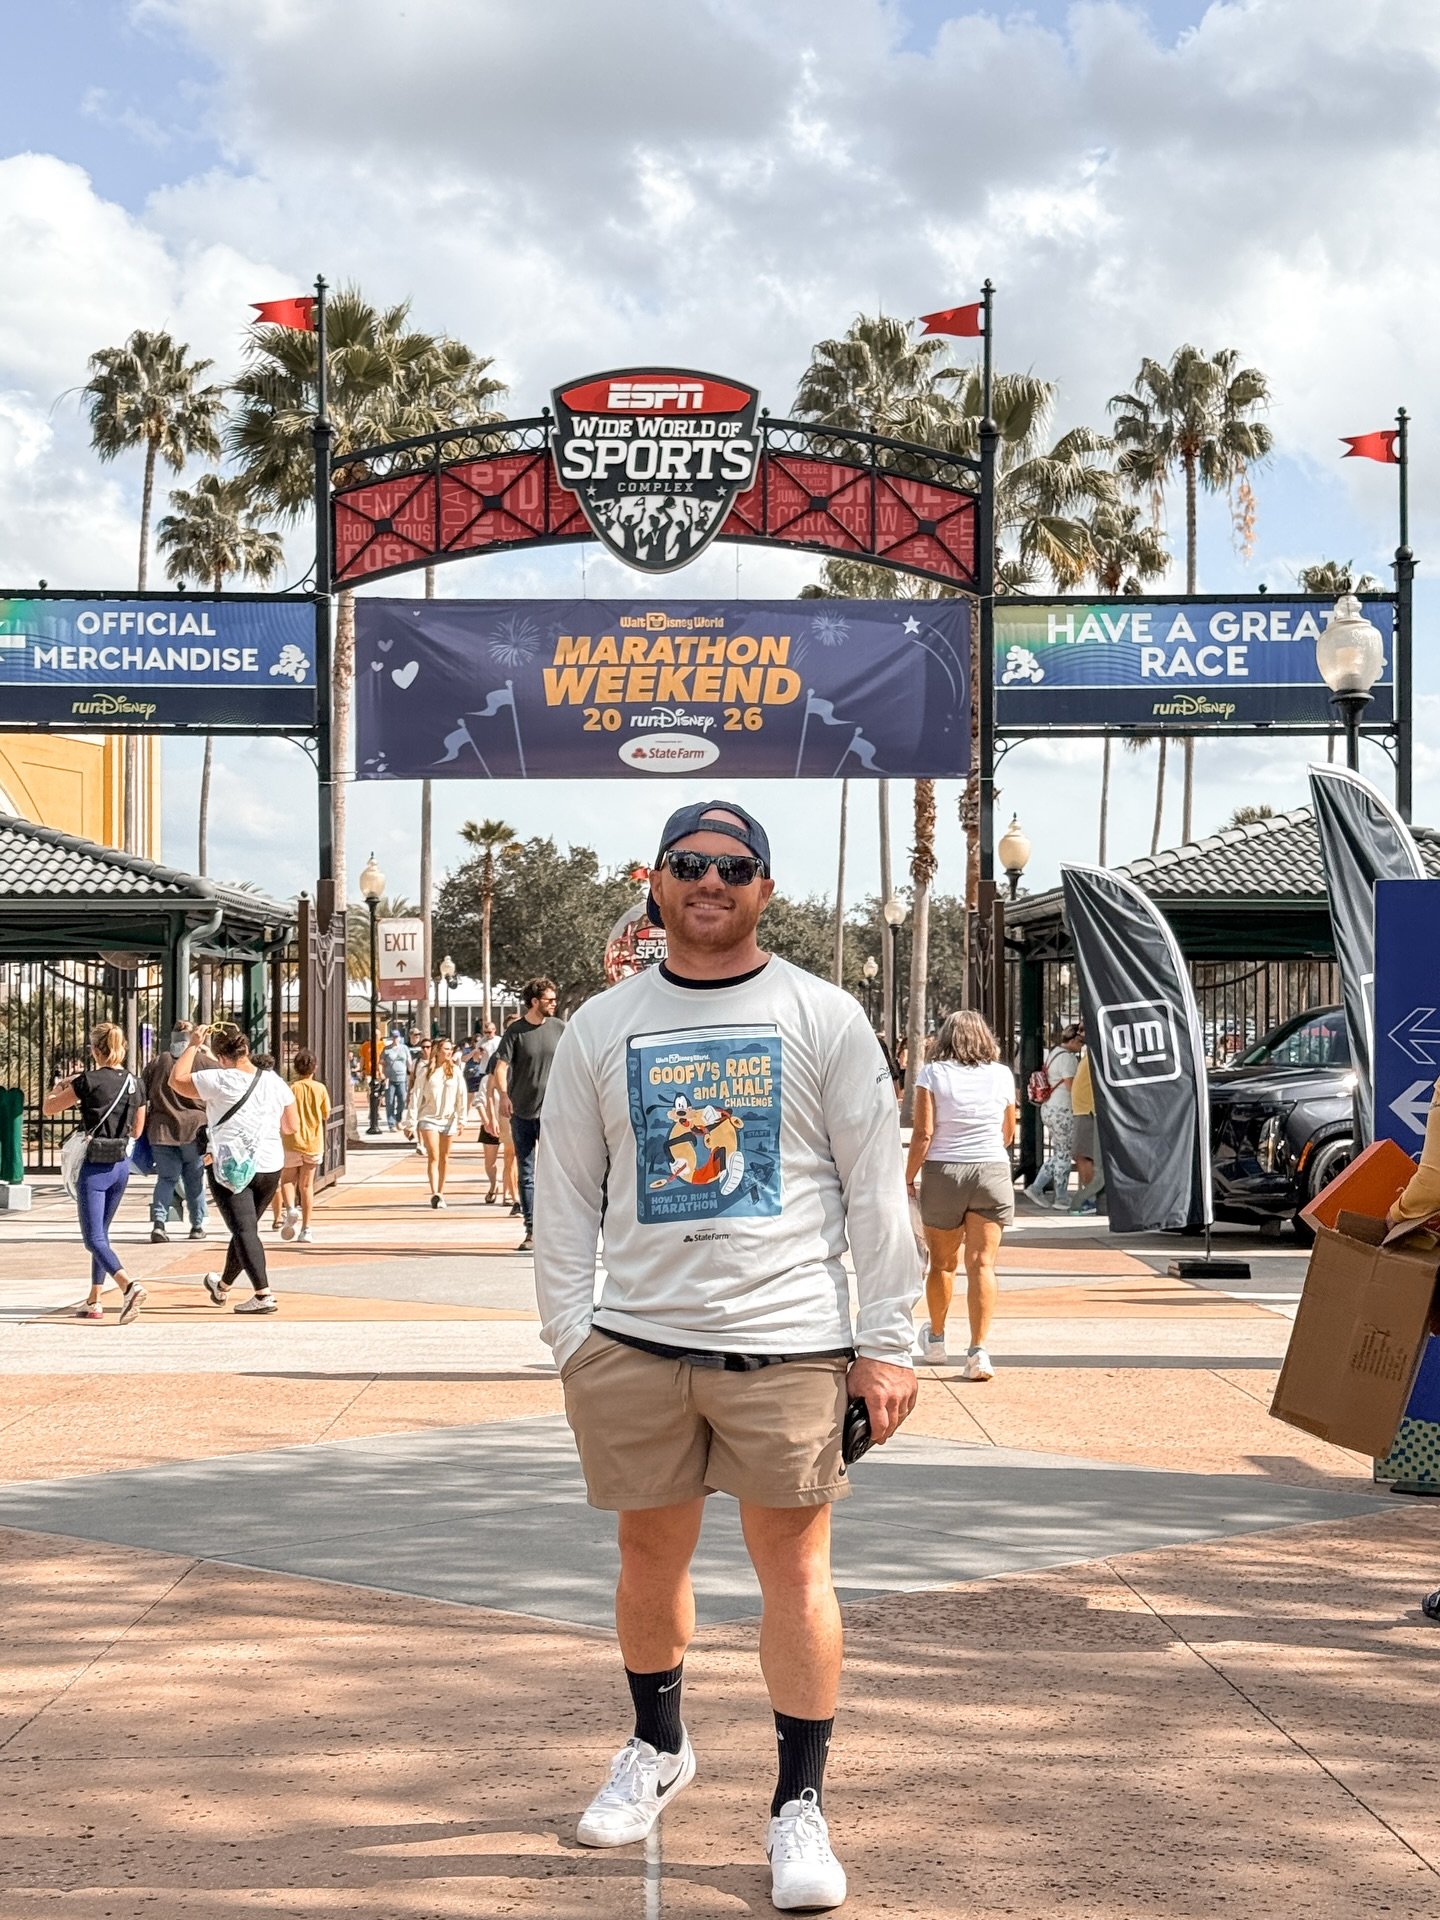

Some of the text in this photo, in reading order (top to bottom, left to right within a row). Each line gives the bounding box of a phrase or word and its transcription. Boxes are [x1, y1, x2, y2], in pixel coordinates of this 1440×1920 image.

[607, 382, 705, 409] ESPN
[571, 416, 743, 438] WIDE WORLD OF
[561, 439, 754, 480] SPORTS
[802, 463, 829, 475] SERVE
[497, 468, 539, 510] TD
[617, 482, 694, 493] COMPLEX
[776, 489, 806, 503] JUMP
[831, 466, 941, 504] DRIVE
[344, 492, 429, 521] TENDU
[777, 506, 898, 532] CORKSCREW
[76, 610, 216, 637] OFFICIAL
[1047, 613, 1153, 644] HAVE
[1165, 613, 1197, 643] A
[33, 646, 259, 672] MERCHANDISE
[552, 636, 792, 667] MARATHON
[1140, 646, 1249, 678] RACE
[542, 665, 802, 707] WEEKEND
[71, 693, 156, 720] runDisney
[582, 707, 623, 732] 20
[722, 706, 764, 732] 26
[1152, 694, 1236, 720] runDisney
[383, 932, 418, 952] EXIT
[1111, 1020, 1165, 1066] gm
[649, 1055, 772, 1086] GOOFY'S RACE
[693, 1077, 773, 1101] and A HALF
[724, 1096, 774, 1108] CHALLENGE
[651, 1195, 673, 1205] HOW
[675, 1194, 688, 1202] TO
[690, 1192, 709, 1201] RUN
[651, 1199, 719, 1215] MARATHON
